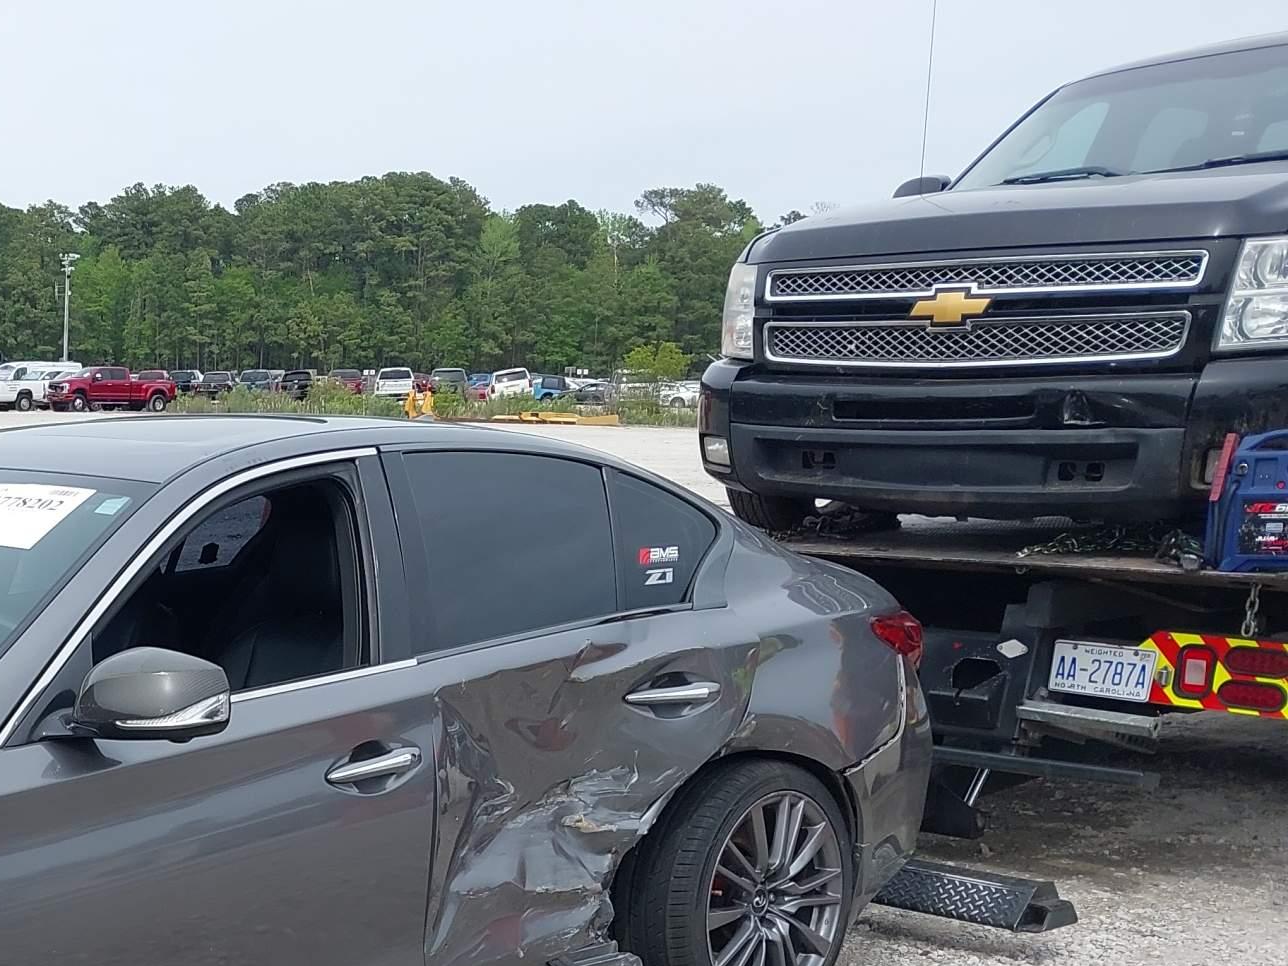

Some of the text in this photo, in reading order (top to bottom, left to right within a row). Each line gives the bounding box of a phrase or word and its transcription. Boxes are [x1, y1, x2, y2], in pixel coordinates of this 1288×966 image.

[1084, 648, 1124, 656] WEIGHTED
[1055, 656, 1147, 689] AA-2787A
[1054, 682, 1141, 697] NORTH CAROLINA
